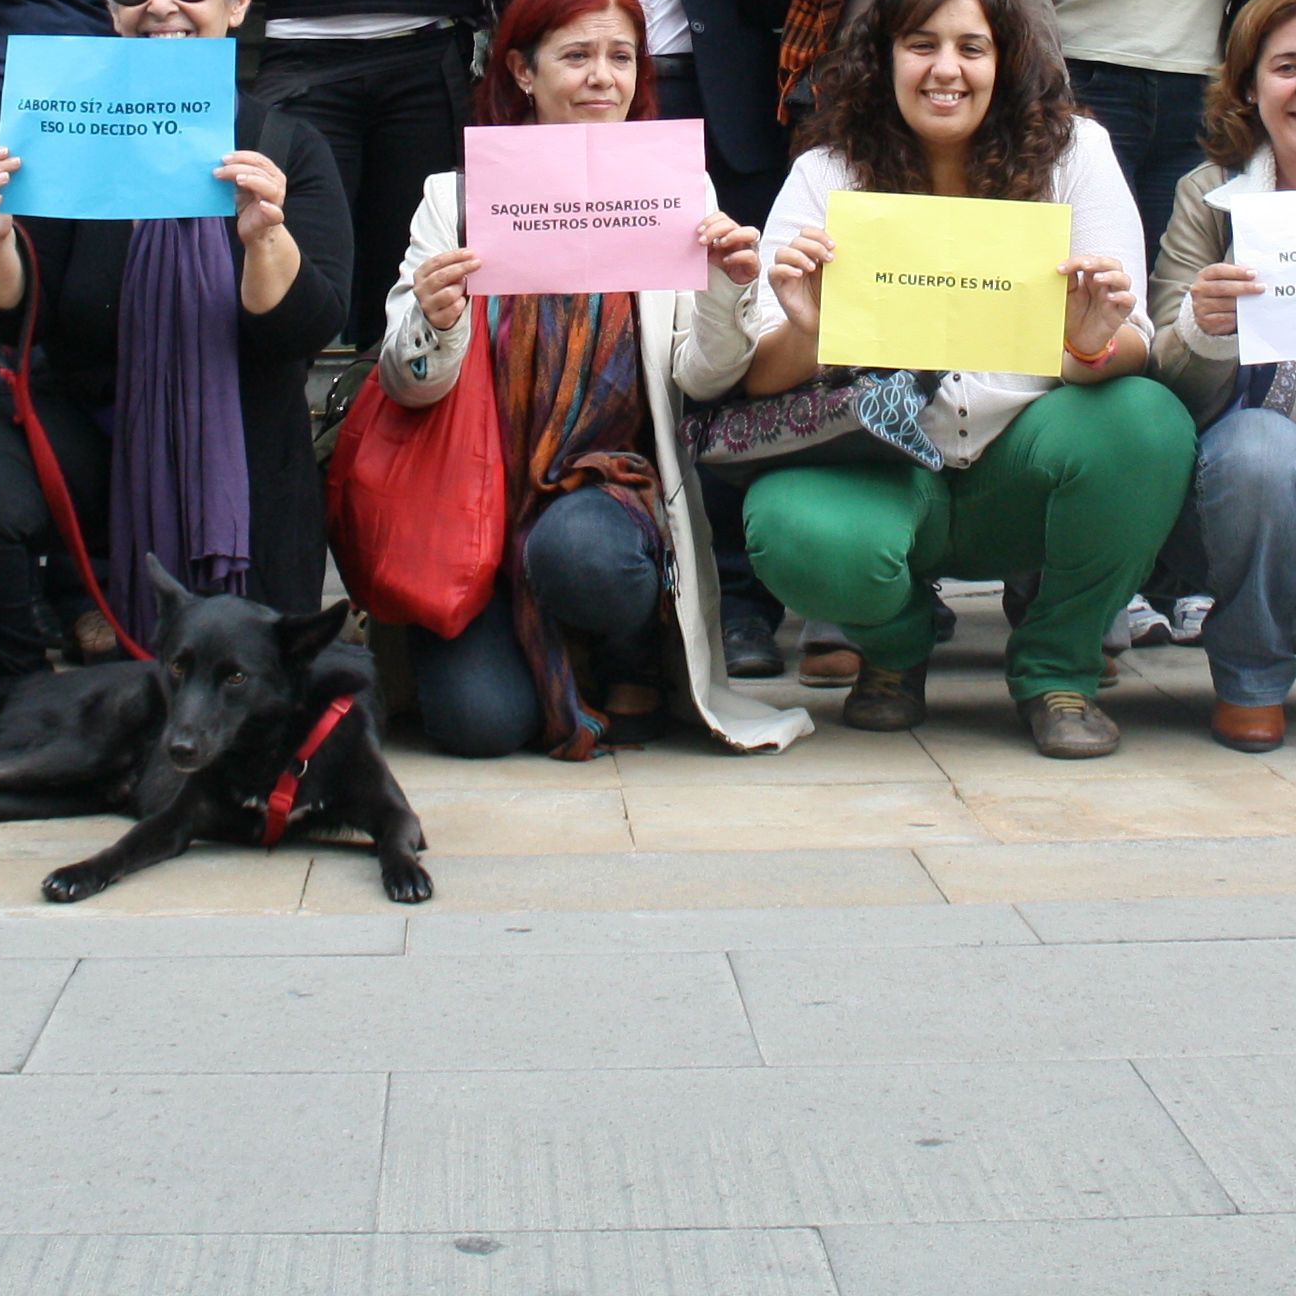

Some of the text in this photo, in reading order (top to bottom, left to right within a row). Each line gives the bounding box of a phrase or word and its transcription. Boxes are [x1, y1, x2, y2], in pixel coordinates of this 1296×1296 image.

[18, 98, 210, 114] ¿ABORTO SÍ? ¿ABORTO NO?
[41, 121, 182, 135] ESO LO DECIDO YO.
[491, 198, 680, 217] SAQUEN SUS ROSARIOS DE
[513, 216, 661, 230] NUESTROS OVARIOS.
[876, 273, 1011, 291] MI CUERPO ES MÍO
